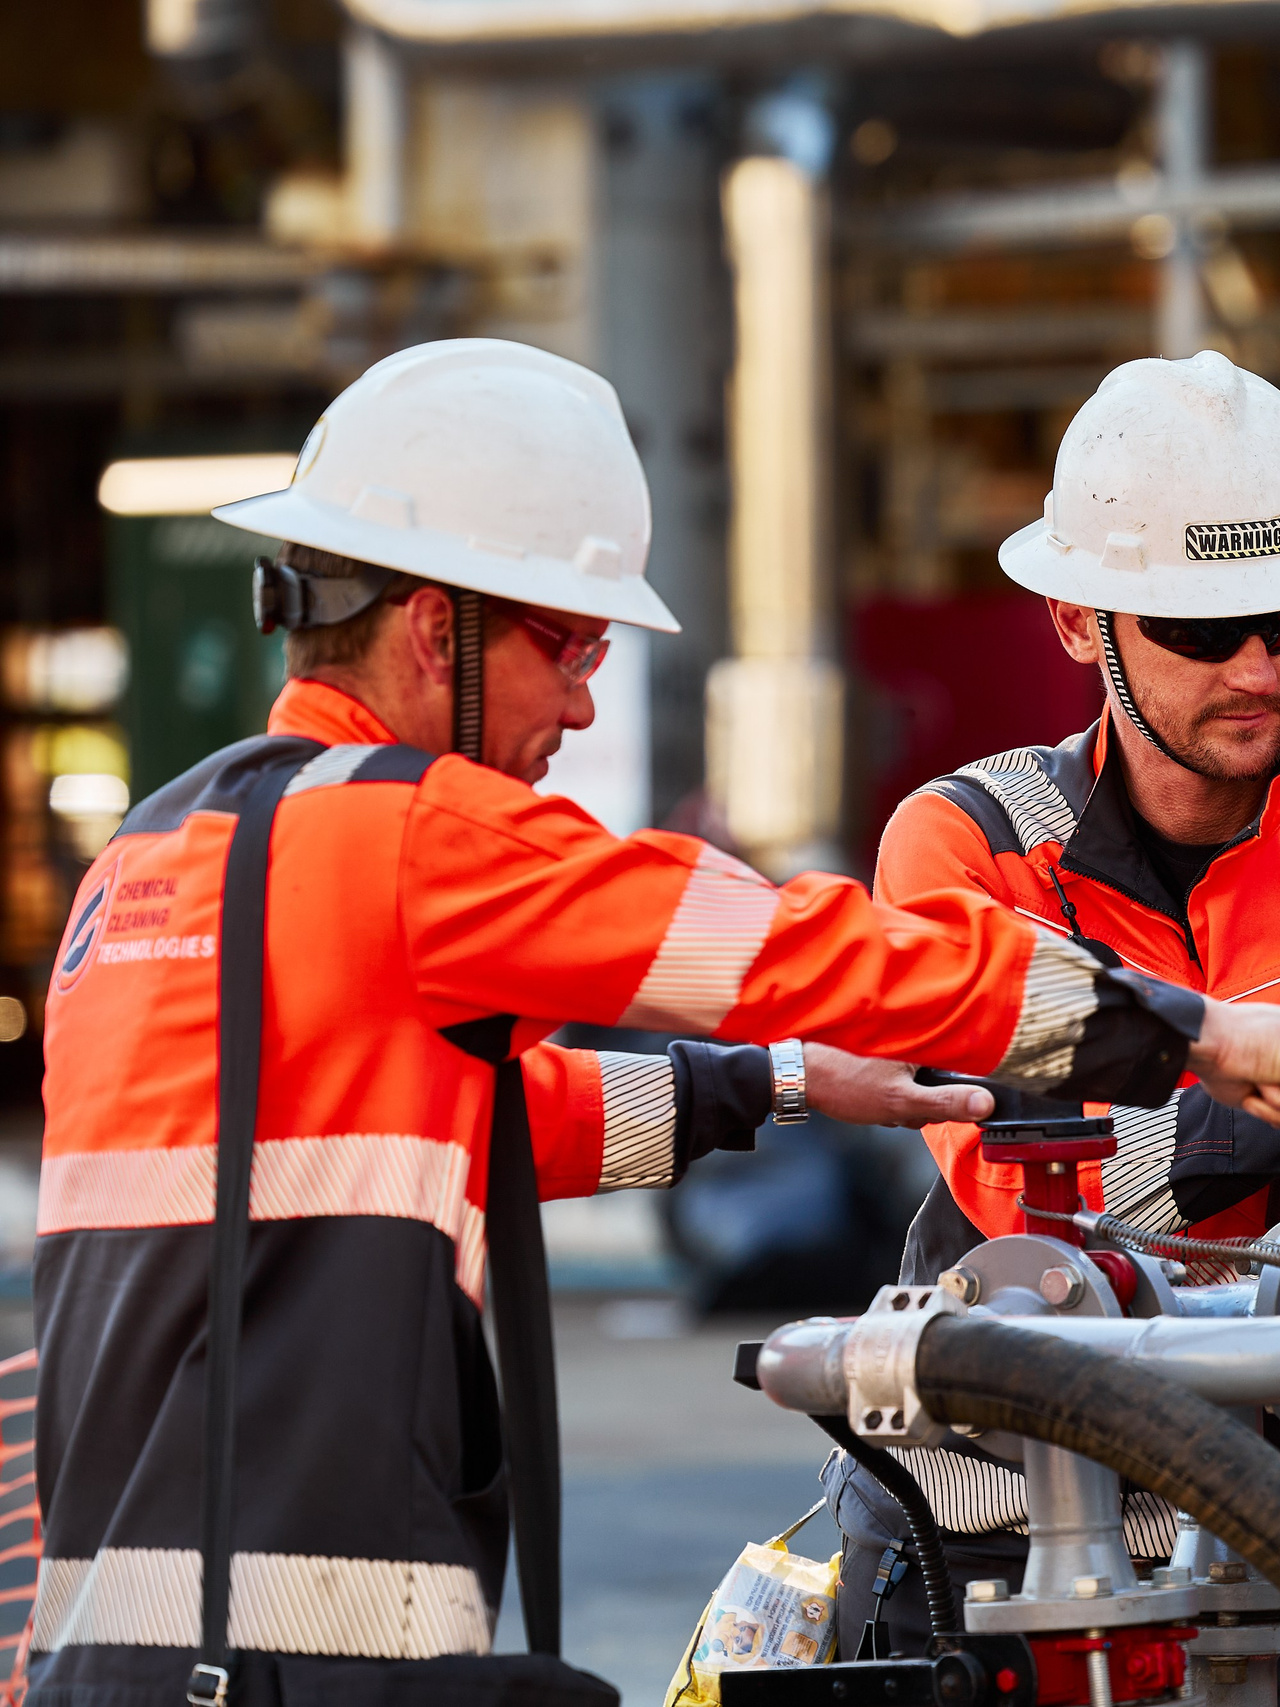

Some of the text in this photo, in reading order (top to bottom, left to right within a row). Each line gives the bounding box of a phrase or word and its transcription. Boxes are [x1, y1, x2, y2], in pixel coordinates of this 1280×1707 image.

[117, 877, 177, 902] CHEMICAL
[106, 908, 171, 933] CLEANING
[96, 934, 217, 965] TECHNOLOGIES
